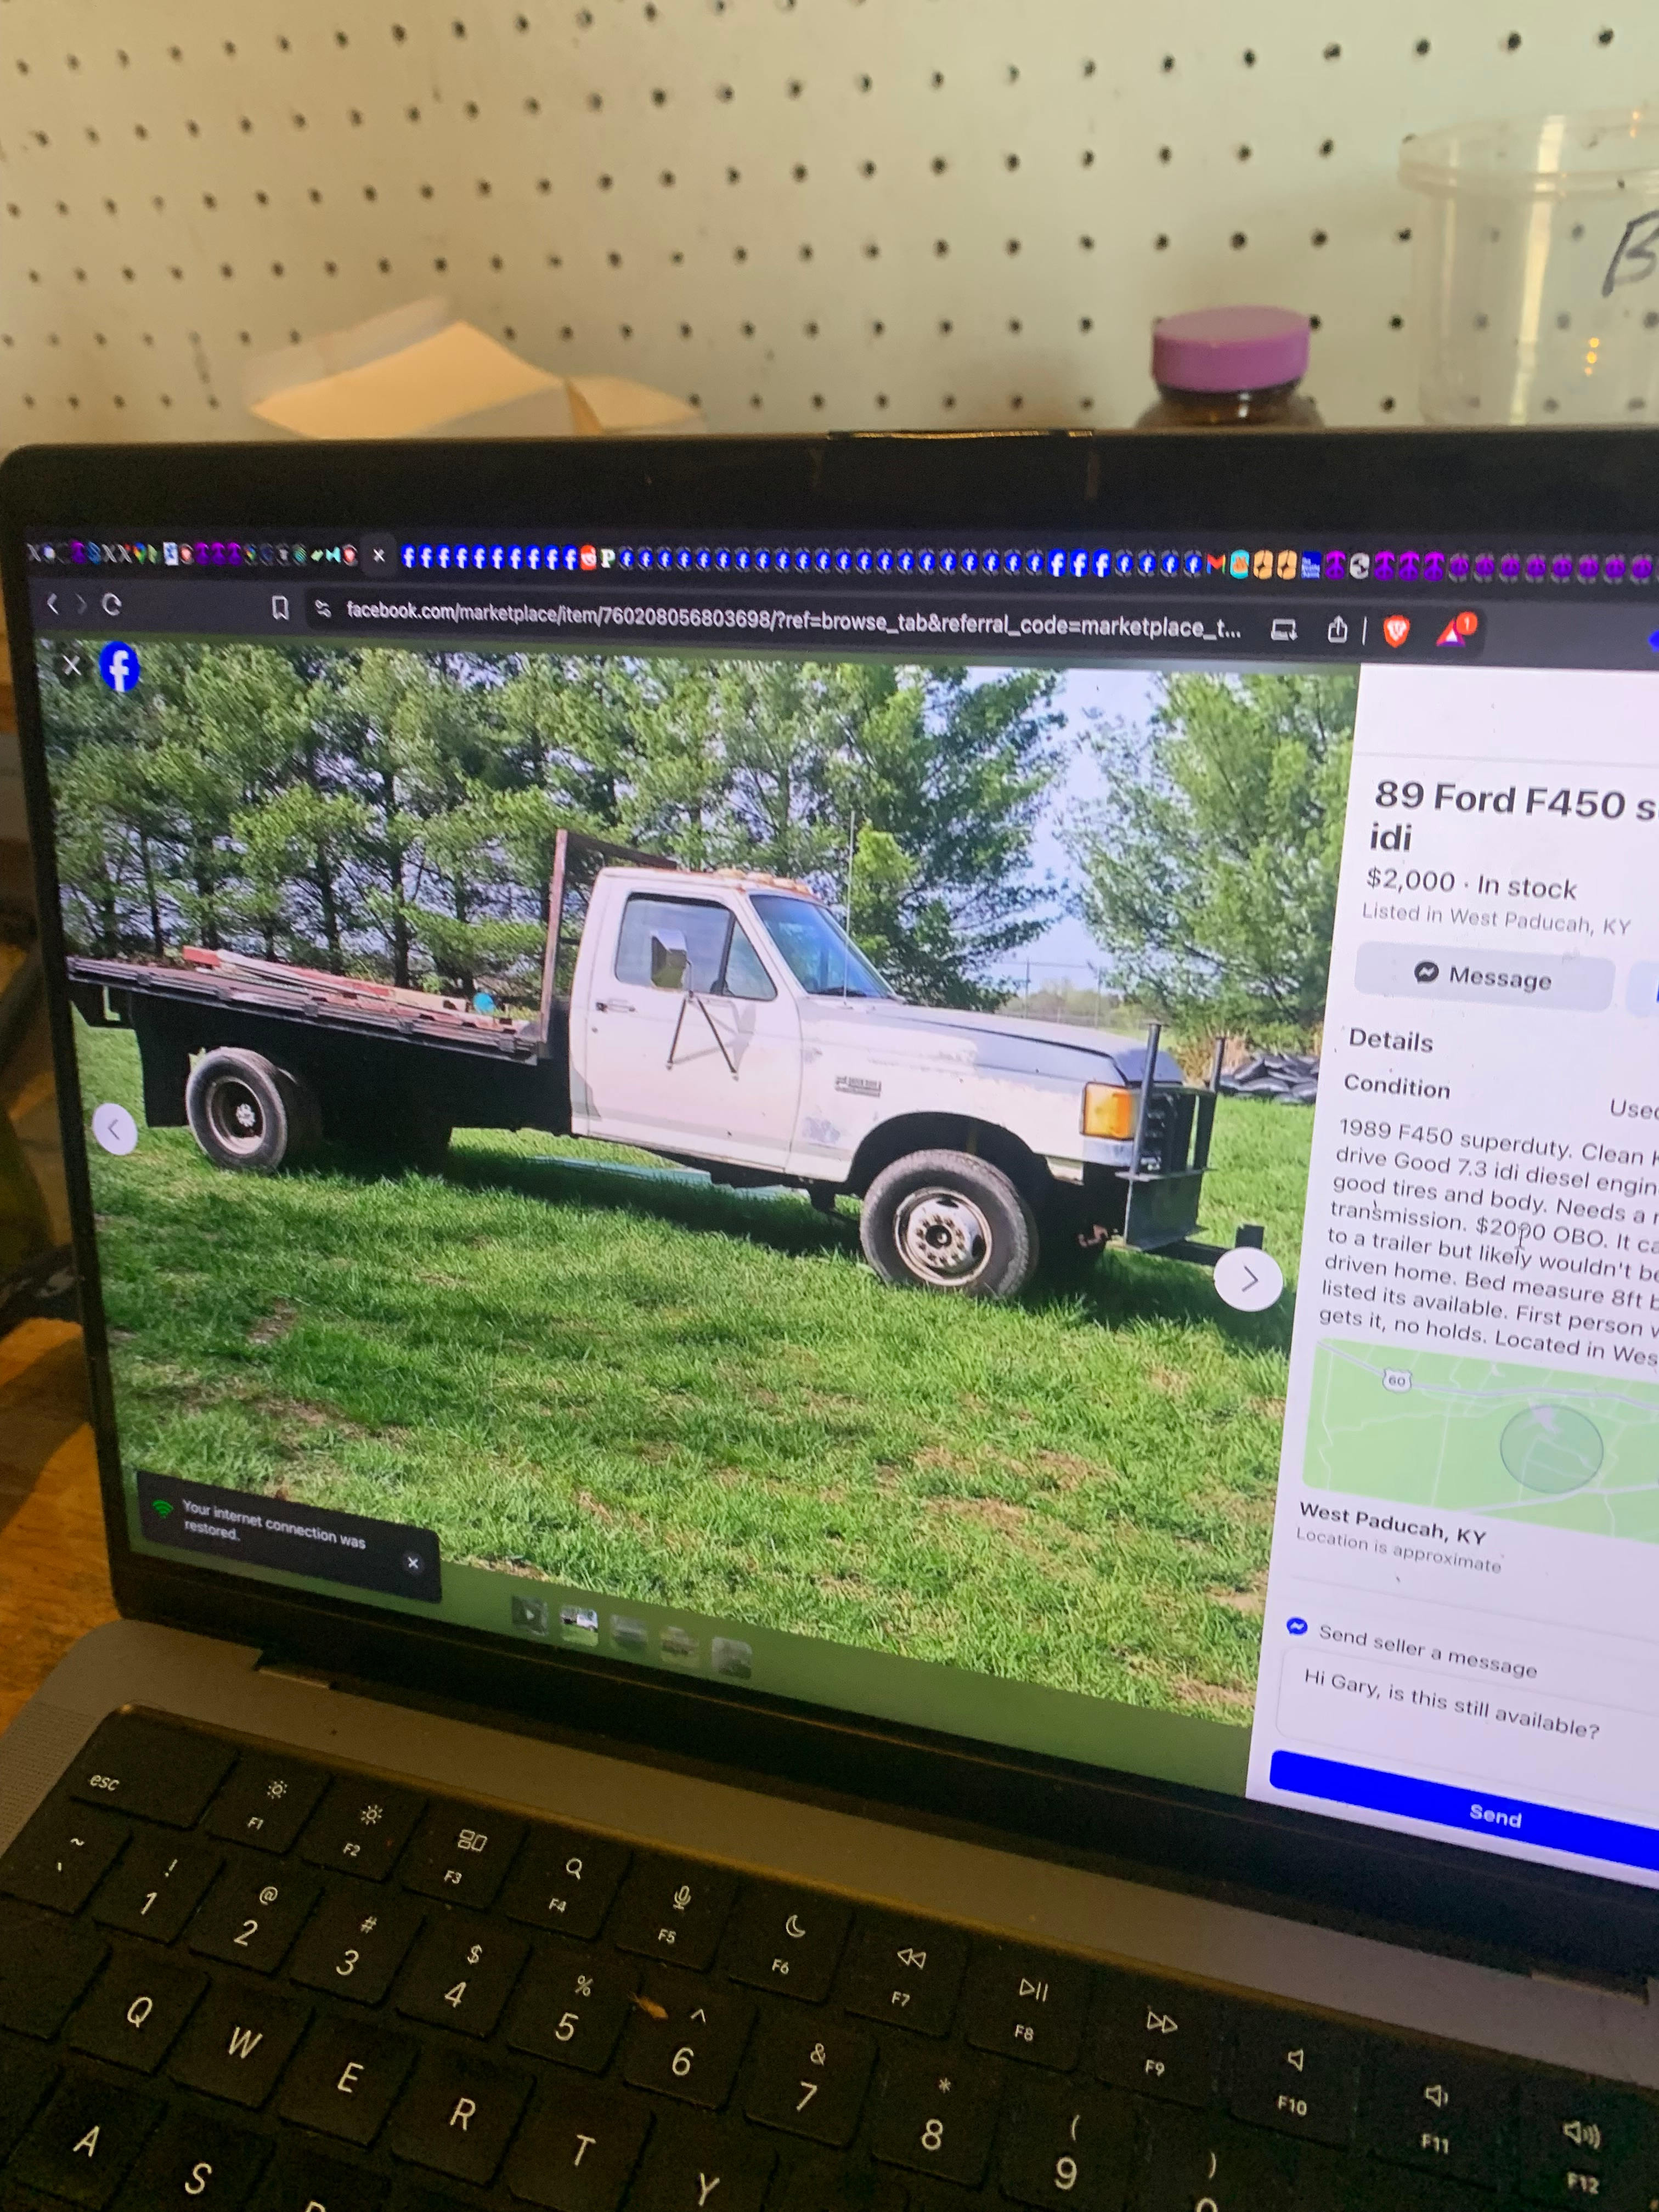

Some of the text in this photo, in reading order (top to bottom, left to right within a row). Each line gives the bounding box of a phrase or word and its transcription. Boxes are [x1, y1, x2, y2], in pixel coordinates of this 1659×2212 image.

[1376, 781, 1424, 808] 89
[1435, 783, 1516, 813] Ford
[1526, 788, 1625, 819] F450
[1371, 822, 1412, 850] idi
[1367, 867, 1455, 893] $2,000
[1479, 876, 1499, 894] In
[1509, 879, 1576, 899] stock
[1363, 902, 1630, 936] Listed in West Paducah, KY
[1450, 967, 1551, 992] Message
[1350, 1028, 1432, 1052] Details
[1345, 1074, 1450, 1099] Condition
[1340, 1119, 1391, 1138] 1989
[1399, 1125, 1453, 1144] F450
[1460, 1136, 1572, 1161] superduty.
[1582, 1143, 1643, 1165] Clean
[1336, 1147, 1386, 1166] drive
[1395, 1153, 1451, 1173] Good
[1459, 1159, 1487, 1177] 7.3
[1495, 1163, 1518, 1180] idi
[1526, 1166, 1589, 1188] diesel
[1334, 1177, 1385, 1194] good
[1393, 1180, 1437, 1199] tires
[1445, 1189, 1483, 1205] and
[1491, 1190, 1546, 1215] body.
[1557, 1198, 1624, 1221] Needs
[1633, 1211, 1645, 1223] a
[1332, 1201, 1466, 1232] transmission.
[1554, 1227, 1607, 1248] OBO.
[1617, 1234, 1629, 1250] It
[1329, 1228, 1347, 1243] to
[1355, 1235, 1364, 1246] a
[1374, 1234, 1431, 1254] trailer
[1439, 1240, 1471, 1259] but
[1480, 1245, 1532, 1269] likely
[1540, 1256, 1630, 1279] wouldn't
[1325, 1255, 1386, 1276] driven
[1395, 1262, 1455, 1284] home.
[1466, 1272, 1505, 1290] Bed
[1513, 1281, 1604, 1303] measure
[1612, 1290, 1641, 1308] 8ft
[1323, 1280, 1376, 1301] listed
[1384, 1288, 1405, 1304] its
[1413, 1296, 1506, 1318] available.
[1517, 1306, 1560, 1325] First
[1568, 1316, 1643, 1336] person
[1320, 1311, 1657, 1365] gets it, no holds. Located in Wes
[1389, 1376, 1406, 1386] 60
[183, 1499, 365, 1549] Your internet connection was
[1301, 1502, 1486, 1545] West Paducah, KY
[1297, 1527, 1501, 1573] Location is approximate
[1320, 1626, 1537, 1678] Send seller a message
[1306, 1669, 1599, 1739] Hi Gary, is this still available?
[90, 1775, 120, 1791] esc
[247, 1817, 263, 1829] F1
[1470, 1804, 1522, 1828] Send
[343, 1843, 360, 1856] F2
[165, 1859, 178, 1877] !
[444, 1870, 462, 1883] F3
[141, 1892, 157, 1915] 1
[259, 1887, 278, 1905] @
[549, 1898, 566, 1912] F4
[234, 1920, 258, 1946] 2
[361, 1917, 377, 1933] #
[658, 1929, 676, 1943] F5
[336, 1950, 359, 1975] 3
[467, 1945, 482, 1964] $
[772, 1959, 789, 1974] F6
[445, 1982, 466, 2007] 4
[575, 1975, 592, 1996] %
[892, 1991, 910, 2006] F7
[127, 1997, 153, 2028] Q
[555, 2012, 578, 2040] 5
[229, 2027, 262, 2058] W
[1015, 2024, 1034, 2041] F8
[672, 2047, 693, 2075] 6
[810, 2043, 825, 2065] &
[1146, 2059, 1165, 2076] F9
[337, 2062, 364, 2092] E
[797, 2081, 817, 2111] 7
[1278, 2095, 1307, 2115] F10
[450, 2098, 476, 2130] R
[1071, 2115, 1080, 2140] (
[73, 2126, 99, 2157] A
[922, 2119, 943, 2150] 8
[1422, 2134, 1448, 2153] F11
[574, 2135, 596, 2166] T
[185, 2163, 212, 2194] S
[1056, 2157, 1077, 2190] 9
[1209, 2153, 1216, 2179] )
[698, 2173, 720, 2206] Y
[1568, 2172, 1599, 2194] F12
